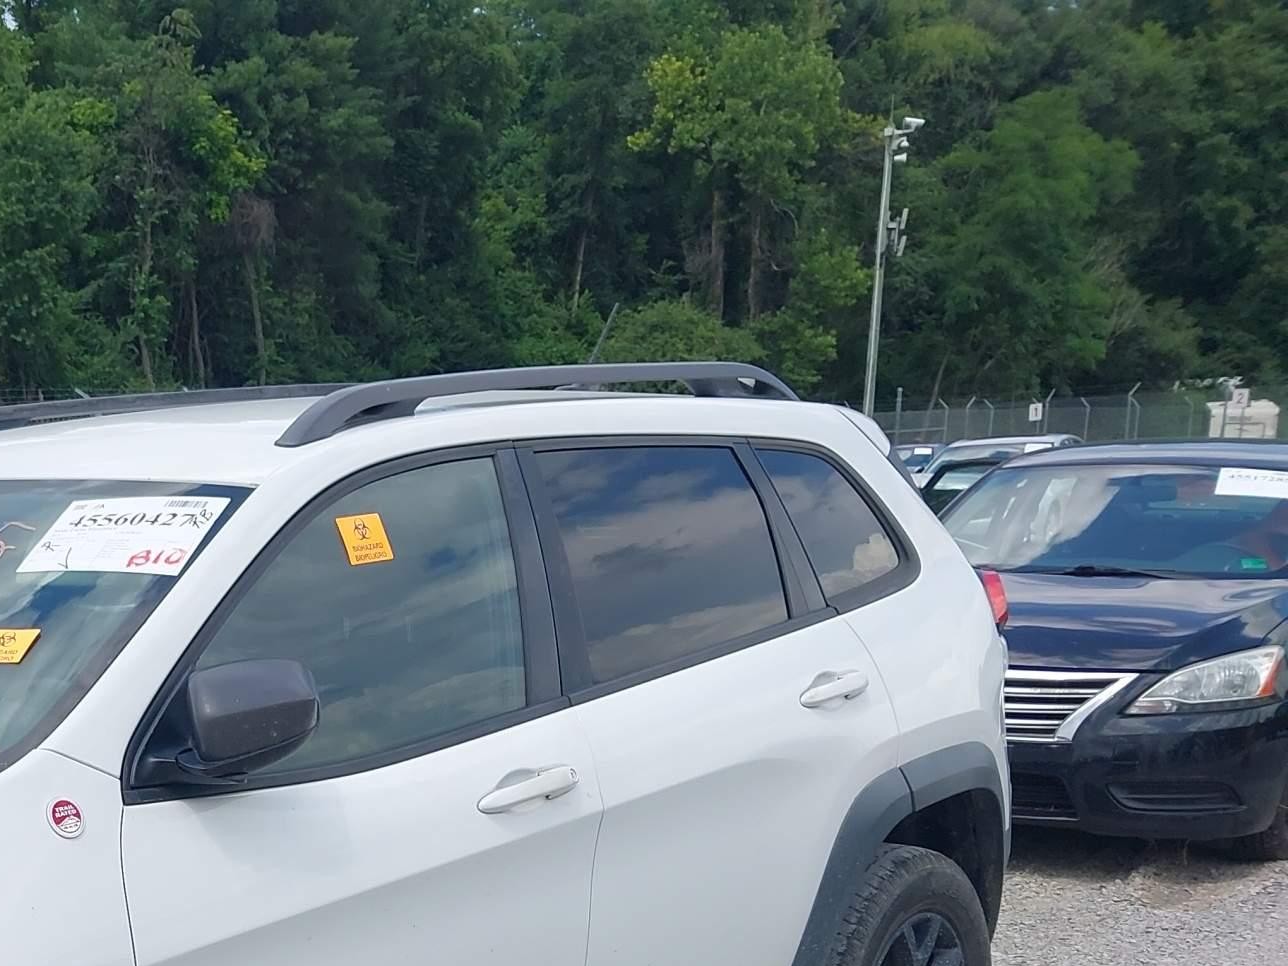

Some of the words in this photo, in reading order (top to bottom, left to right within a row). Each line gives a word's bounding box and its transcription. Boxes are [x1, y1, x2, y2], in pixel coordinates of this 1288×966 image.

[69, 512, 195, 528] 45560427
[54, 804, 74, 813] TRAIL
[55, 809, 77, 818] RATED
